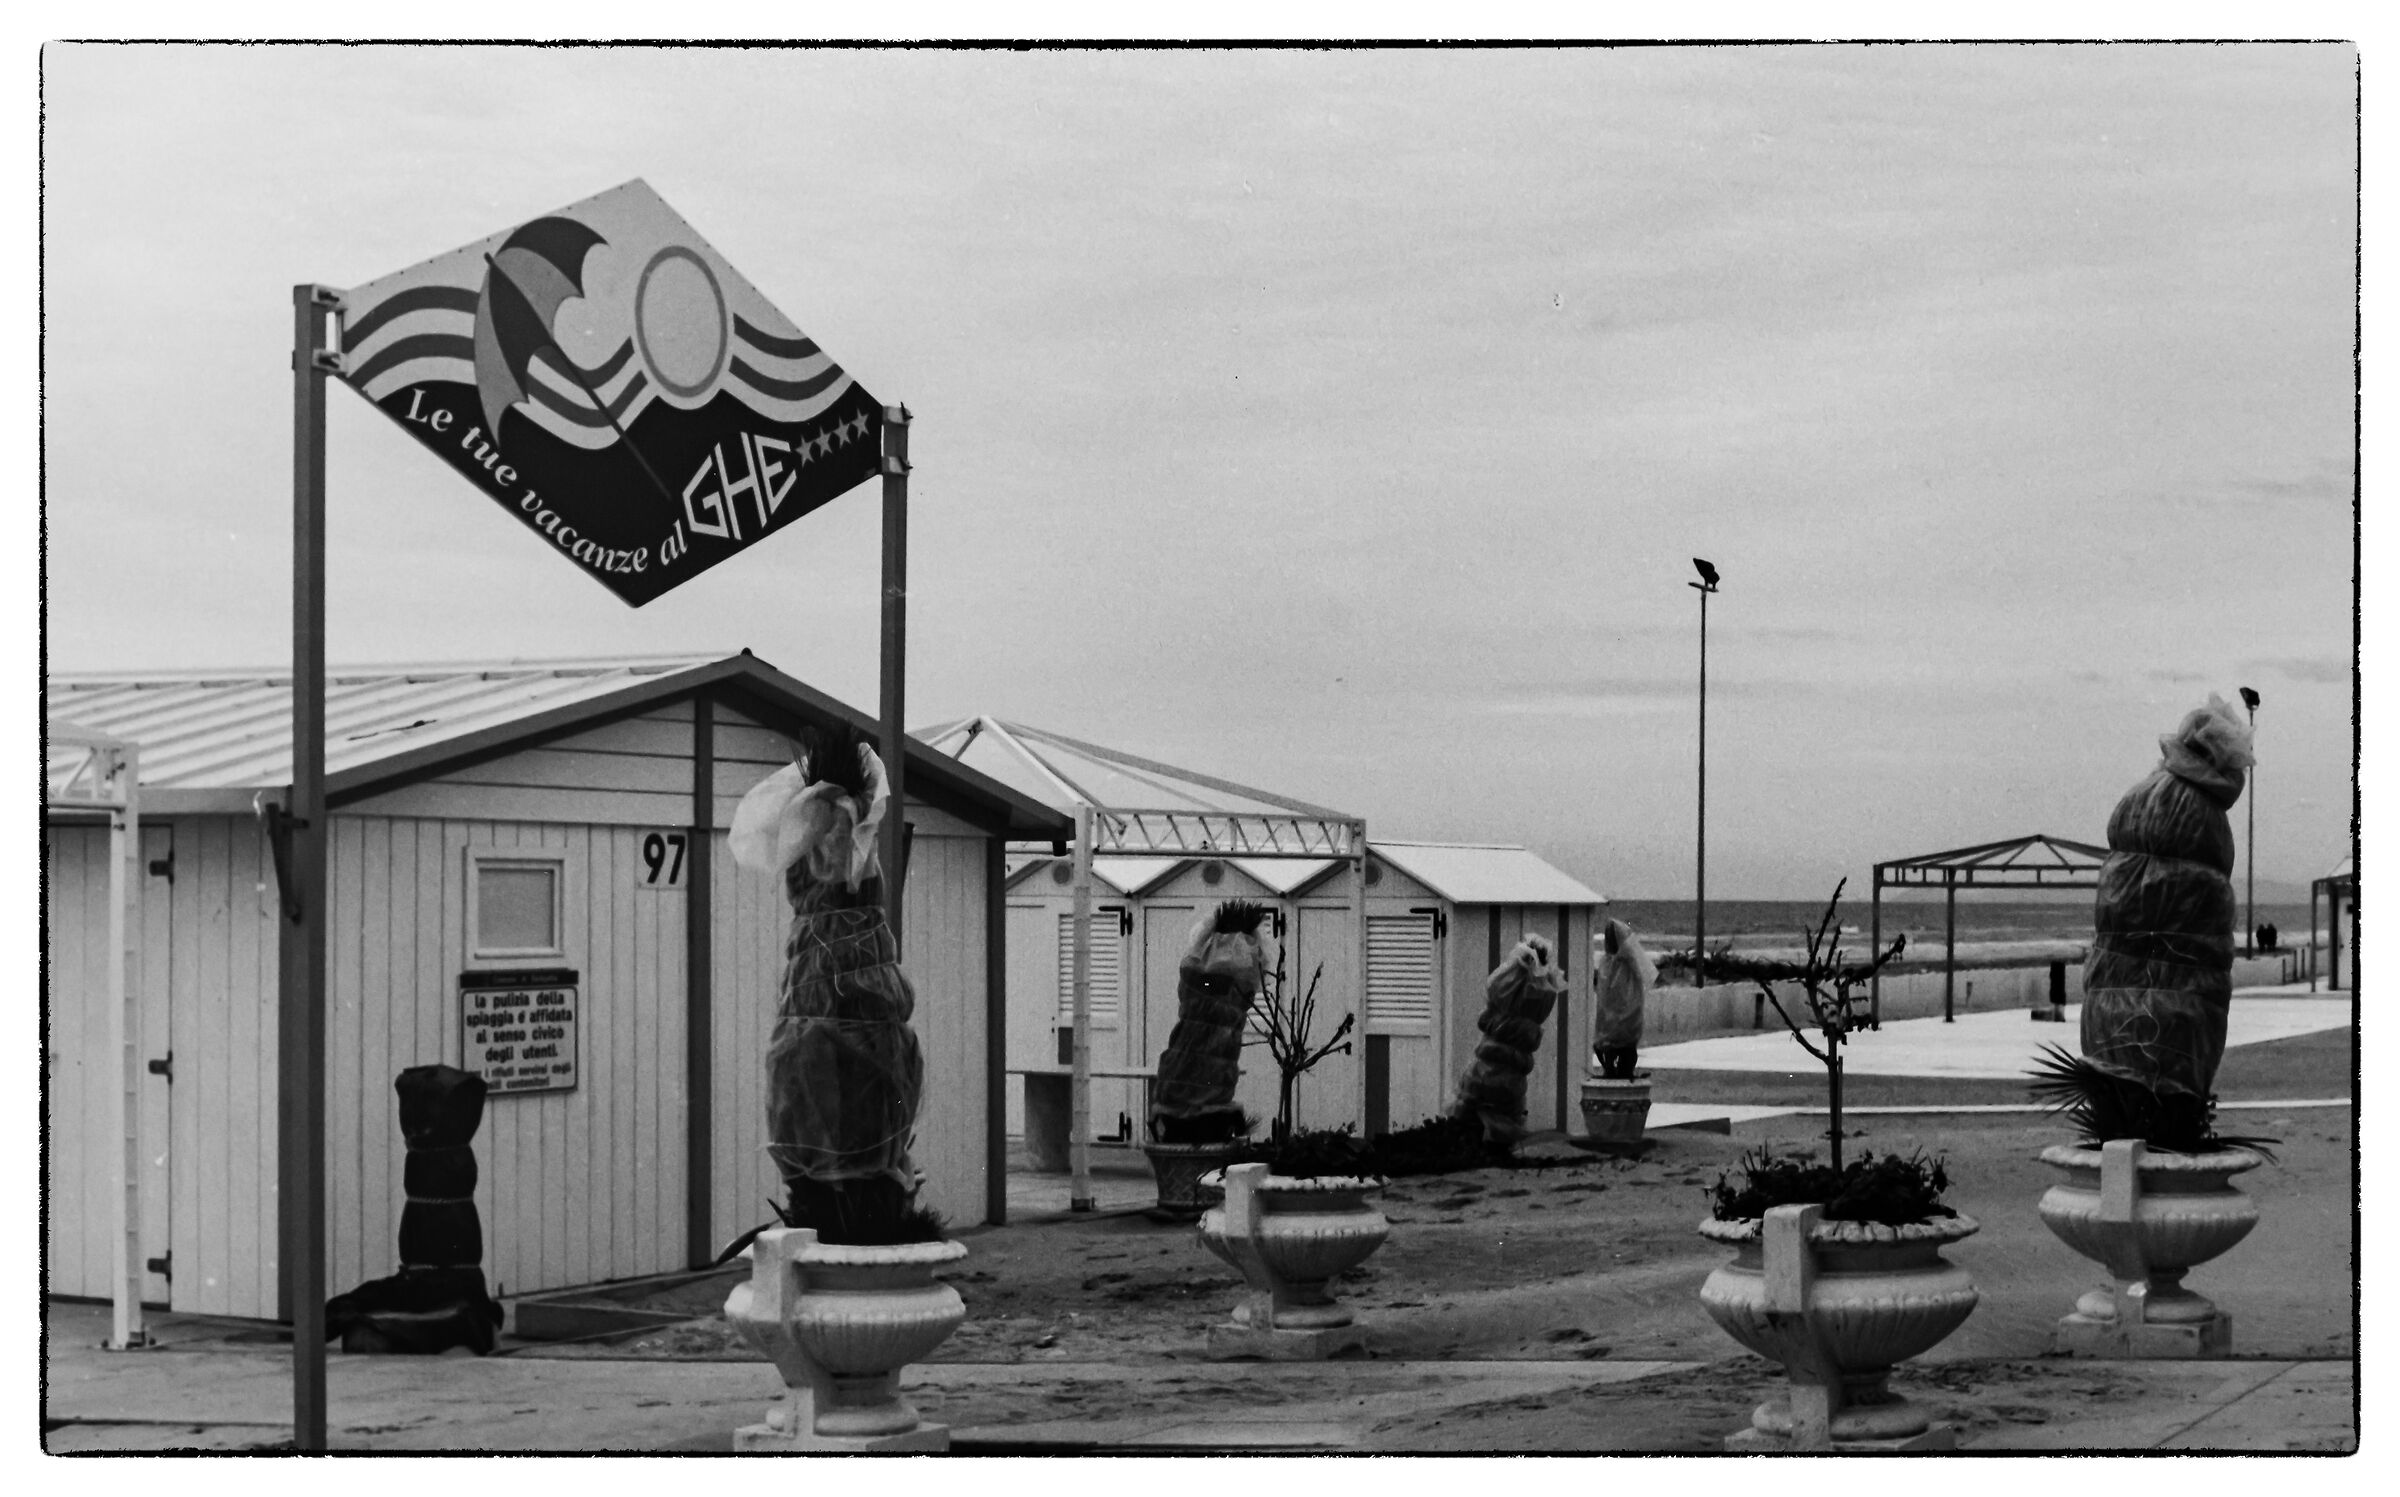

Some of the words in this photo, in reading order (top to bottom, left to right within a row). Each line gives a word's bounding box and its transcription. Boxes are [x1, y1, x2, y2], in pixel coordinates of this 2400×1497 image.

[404, 388, 454, 432] Le
[461, 425, 518, 488] tue
[519, 487, 650, 574] vacanze
[659, 518, 689, 567] al
[682, 431, 797, 541] GHE
[643, 832, 686, 885] 97
[492, 992, 530, 1010] pulizia
[536, 991, 565, 1006] della
[466, 1010, 514, 1028] spiaggia
[529, 1008, 573, 1023] affidata
[475, 1028, 487, 1044] al
[493, 1030, 526, 1043] senso
[531, 1026, 564, 1041] civico
[485, 1046, 514, 1063] degli
[522, 1043, 558, 1060] utenti.
